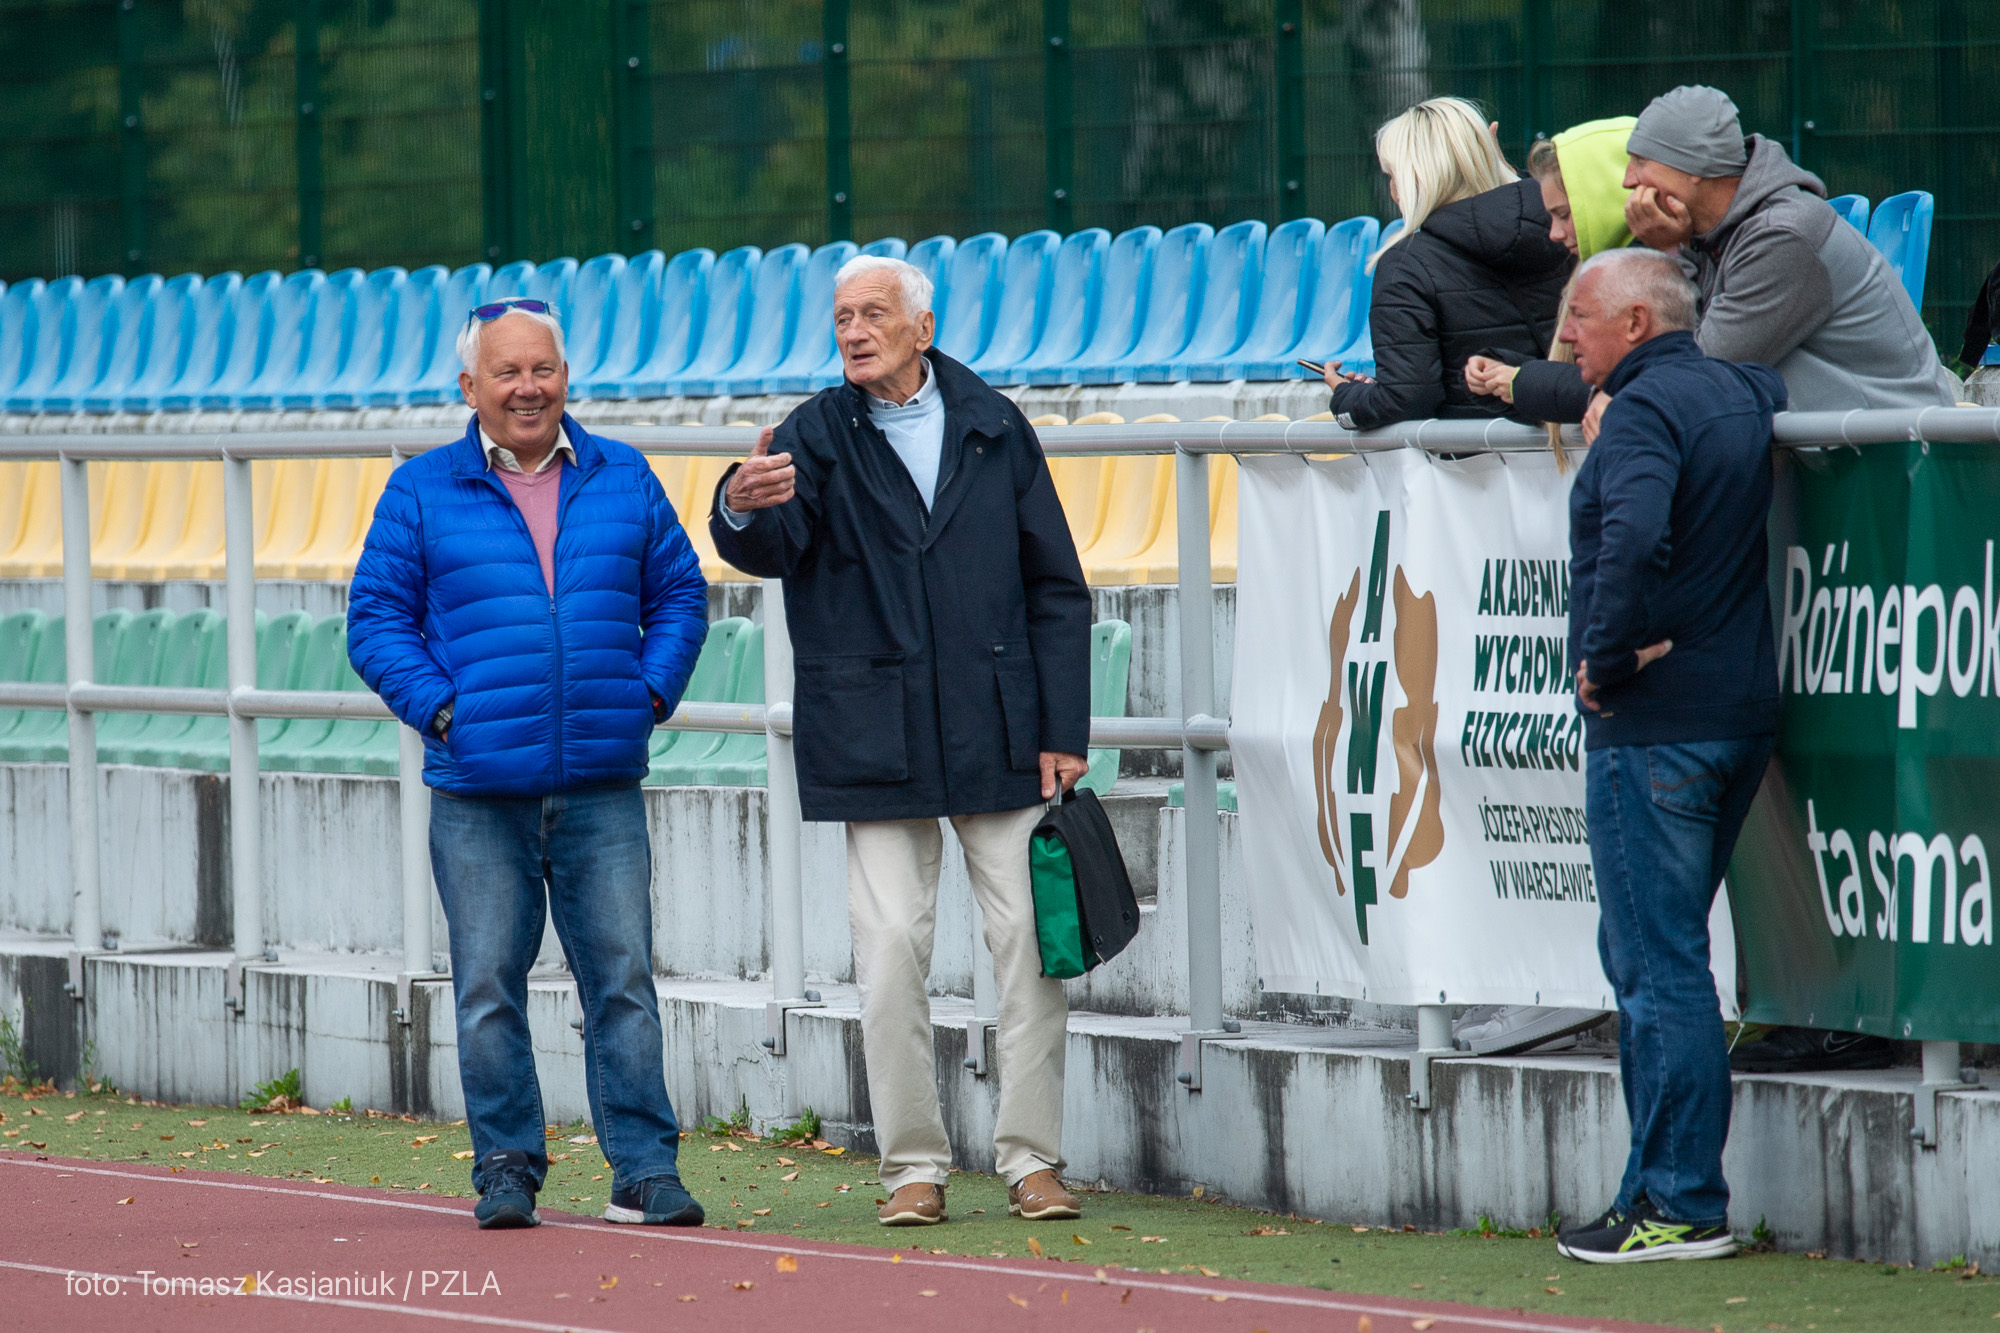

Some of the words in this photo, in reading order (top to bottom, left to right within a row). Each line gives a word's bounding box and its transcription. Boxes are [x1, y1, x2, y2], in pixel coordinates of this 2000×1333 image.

[1460, 710, 1582, 773] FIZYCZNEGO
[1478, 795, 1535, 843] JÓZEFA
[1489, 860, 1508, 899] W
[1508, 860, 1597, 903] WARSZAWIE
